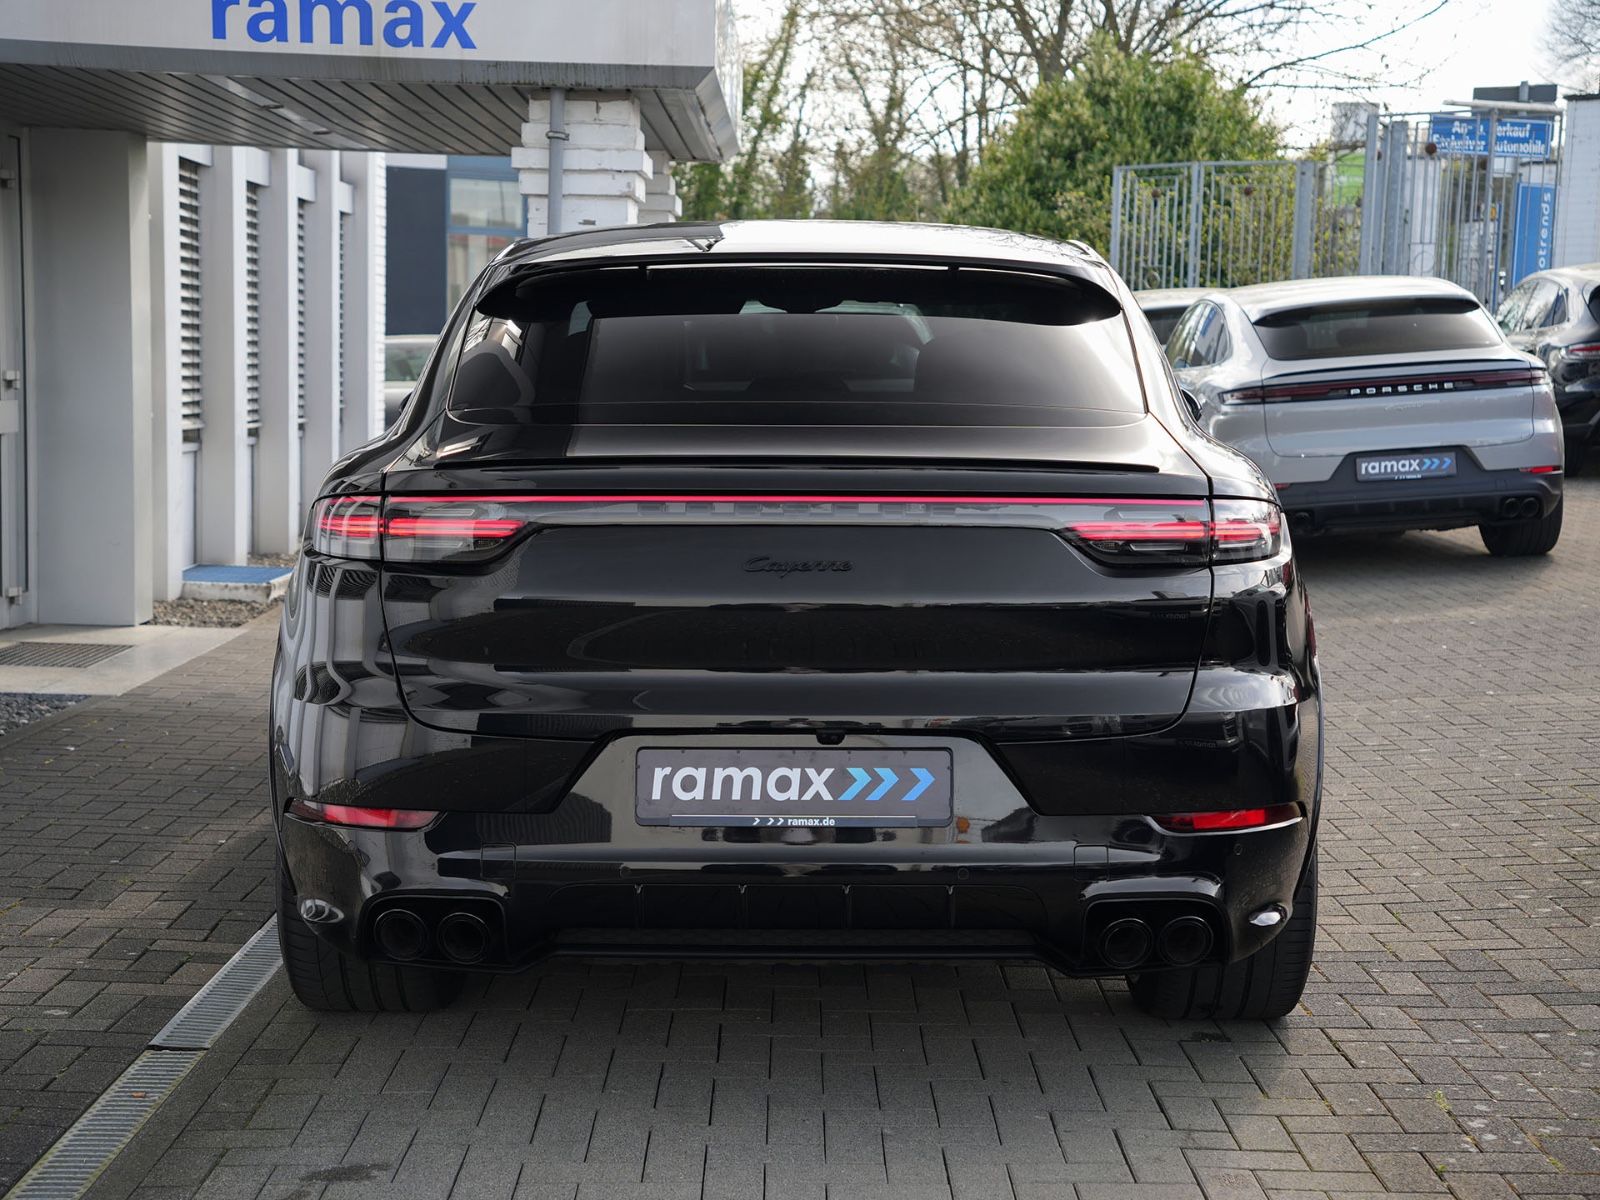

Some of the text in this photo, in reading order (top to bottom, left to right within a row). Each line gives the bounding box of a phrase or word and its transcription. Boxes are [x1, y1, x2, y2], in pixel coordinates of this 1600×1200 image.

[211, 0, 478, 49] ramax
[1493, 123, 1531, 138] erkauf
[1494, 139, 1545, 154] utomobile
[1538, 192, 1552, 270] otrends
[1350, 382, 1454, 396] PORSCHE
[1361, 458, 1421, 475] ramax
[652, 766, 835, 801] ramax
[787, 817, 836, 827] ramax.de
